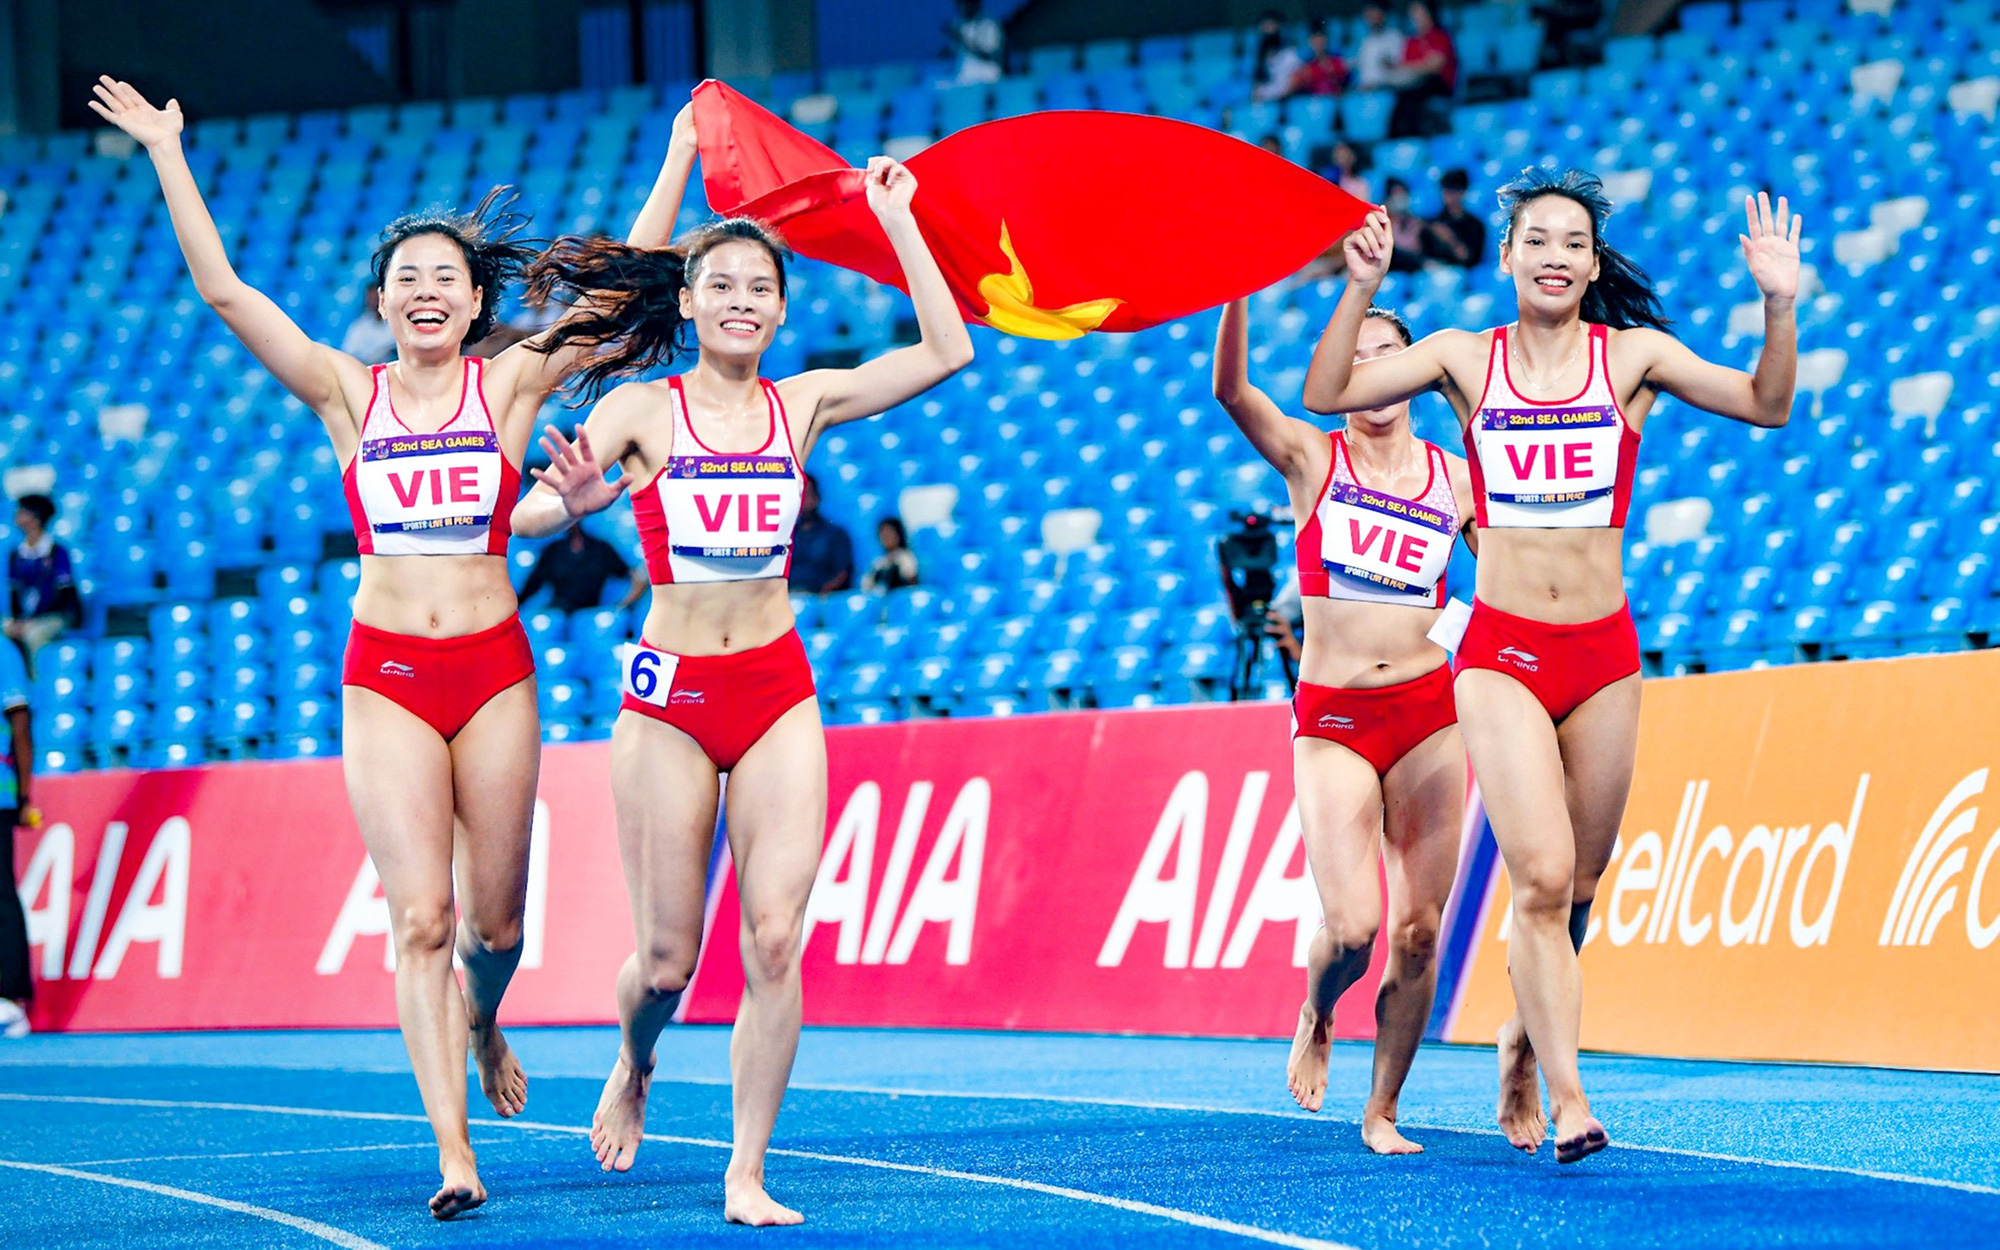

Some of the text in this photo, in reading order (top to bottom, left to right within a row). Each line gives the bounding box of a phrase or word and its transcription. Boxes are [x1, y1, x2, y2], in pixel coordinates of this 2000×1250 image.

[1509, 411, 1602, 425] 32nd SEA GAMES
[391, 436, 485, 453] 32nd SEA GAMES
[1504, 442, 1594, 481] VIE
[387, 465, 480, 509] VIE
[700, 462, 786, 473] 32nd SEA GAMES
[693, 494, 781, 532] VIE
[1360, 493, 1442, 526] 32nd SEA GAMES
[1348, 518, 1429, 573] VIE
[631, 651, 661, 698] 6
[801, 777, 992, 965] AIA
[1582, 773, 1871, 948] ellcard
[17, 815, 192, 981] AIA
